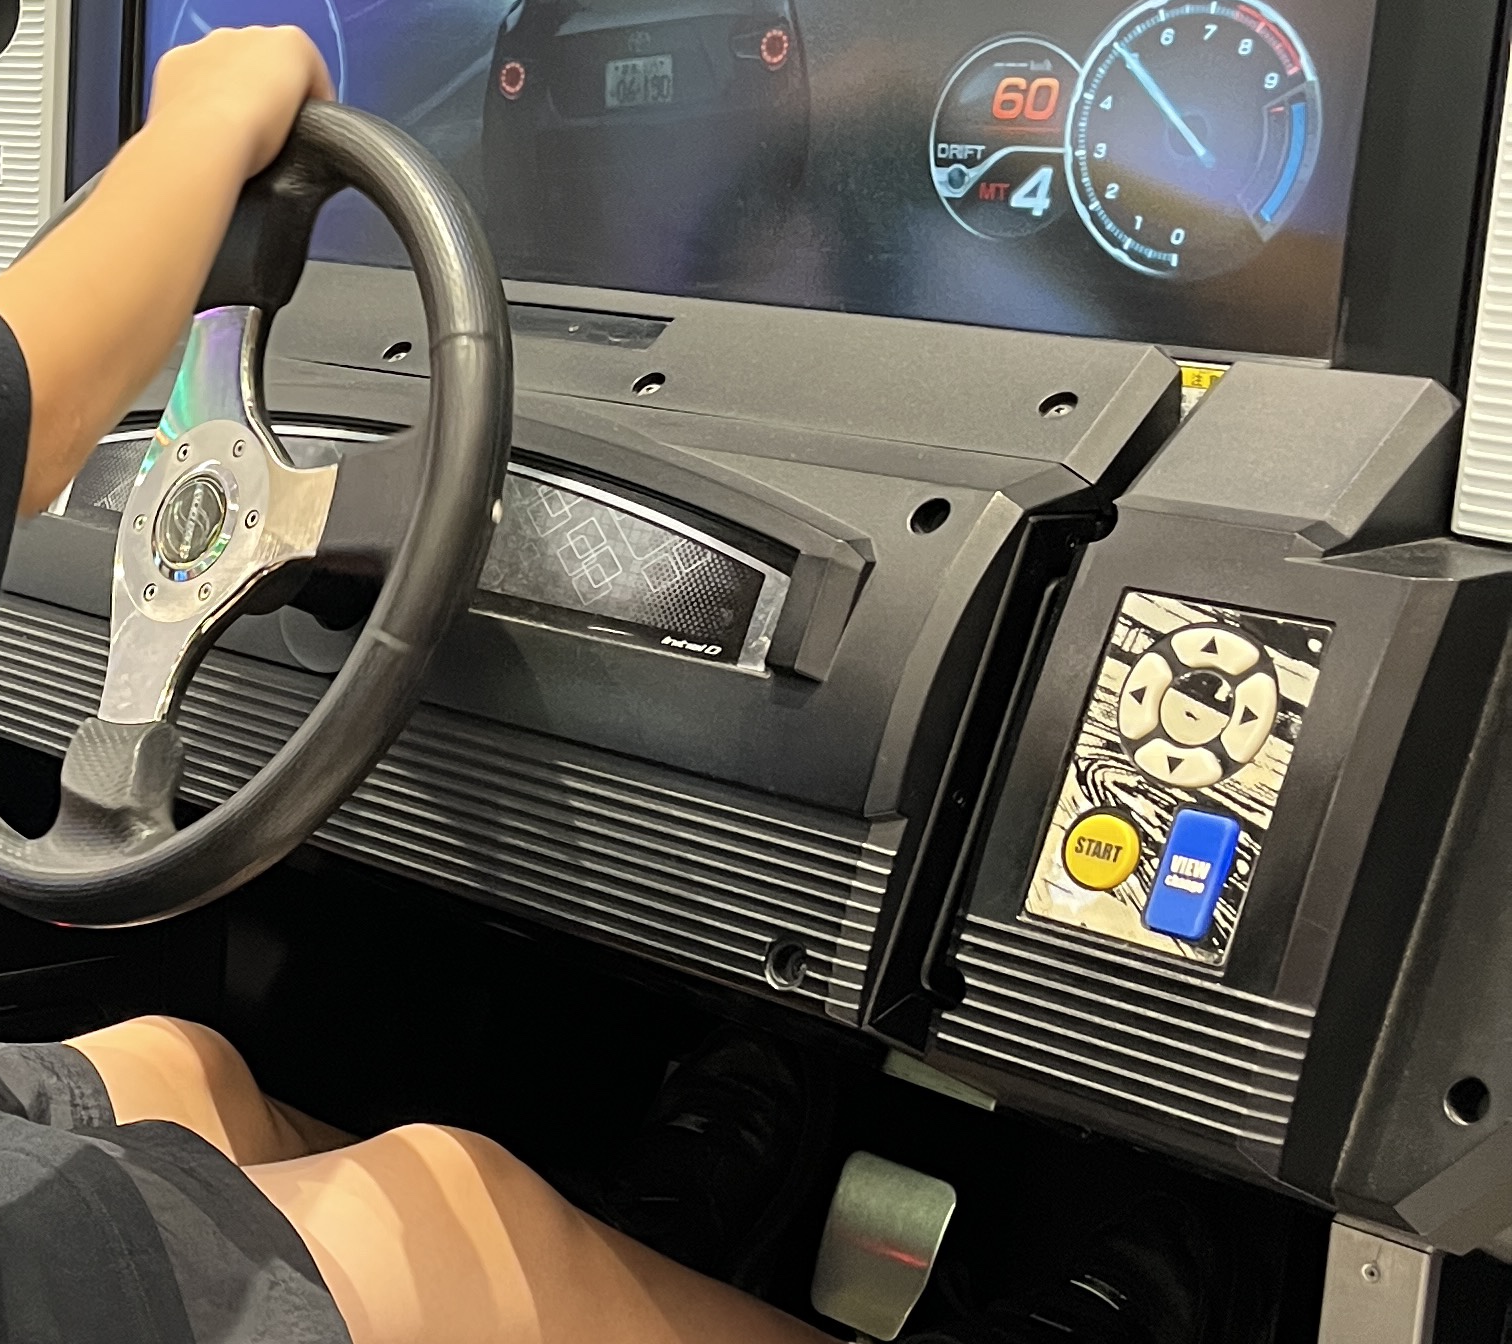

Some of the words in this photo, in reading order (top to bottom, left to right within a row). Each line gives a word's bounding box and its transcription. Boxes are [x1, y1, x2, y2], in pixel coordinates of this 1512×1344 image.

[1159, 28, 1176, 47] 6
[1203, 24, 1218, 41] 7
[1237, 38, 1254, 56] 8
[1263, 72, 1280, 90] 9
[992, 76, 1060, 120] 60
[1099, 95, 1113, 111] 4
[937, 142, 986, 160] DRIFT
[1092, 142, 1108, 159] 3
[978, 182, 1010, 201] MT
[1009, 165, 1055, 217] 4
[1104, 182, 1120, 200] 2
[1134, 215, 1144, 231] 1
[1169, 227, 1186, 245] 0
[1074, 835, 1124, 864] START
[1169, 854, 1212, 880] VIEW
